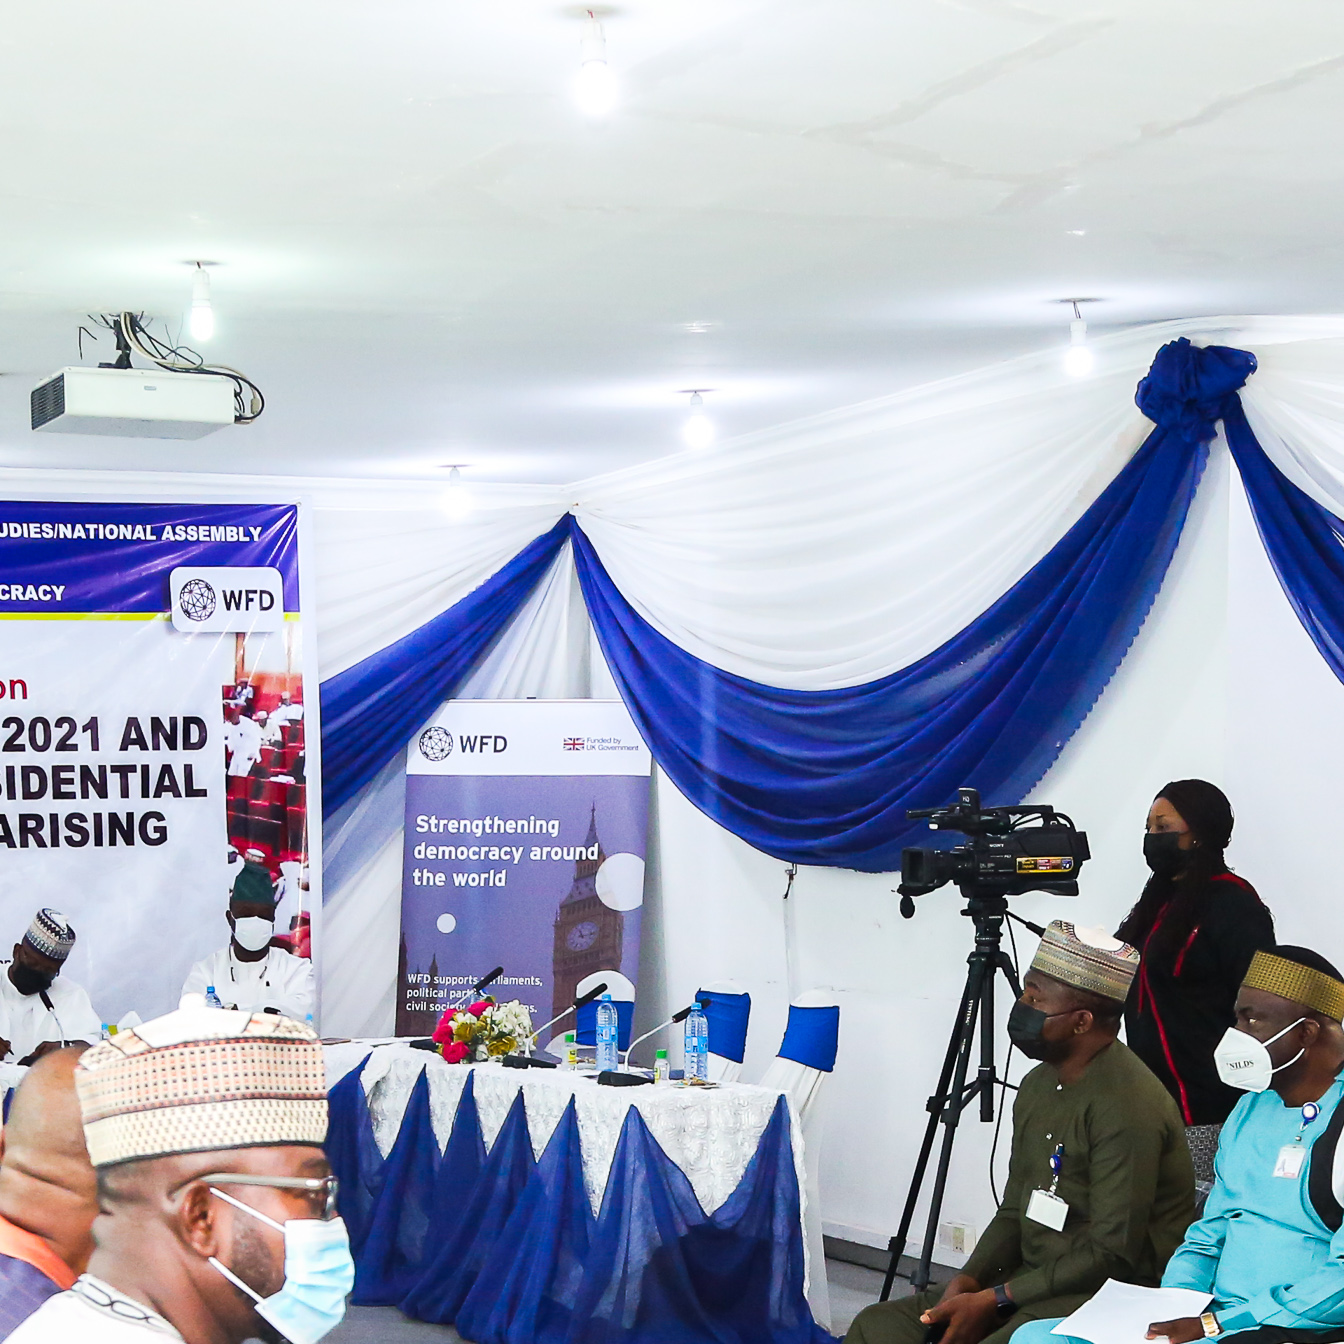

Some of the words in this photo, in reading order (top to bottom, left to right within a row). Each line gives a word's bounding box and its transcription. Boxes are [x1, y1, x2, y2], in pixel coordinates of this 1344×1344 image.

[161, 524, 263, 543] ASSEMBLY
[221, 588, 276, 612] WFD
[1, 716, 99, 753] 2021
[118, 715, 209, 752] AND
[459, 735, 509, 753] WFD
[415, 814, 561, 837] Strengthening
[413, 842, 524, 864] democracy
[529, 843, 600, 861] around
[413, 868, 447, 886] the
[452, 868, 507, 887] world
[407, 973, 431, 984] WFD
[433, 974, 478, 987] supports
[406, 988, 447, 999] political
[405, 1001, 427, 1012] civil
